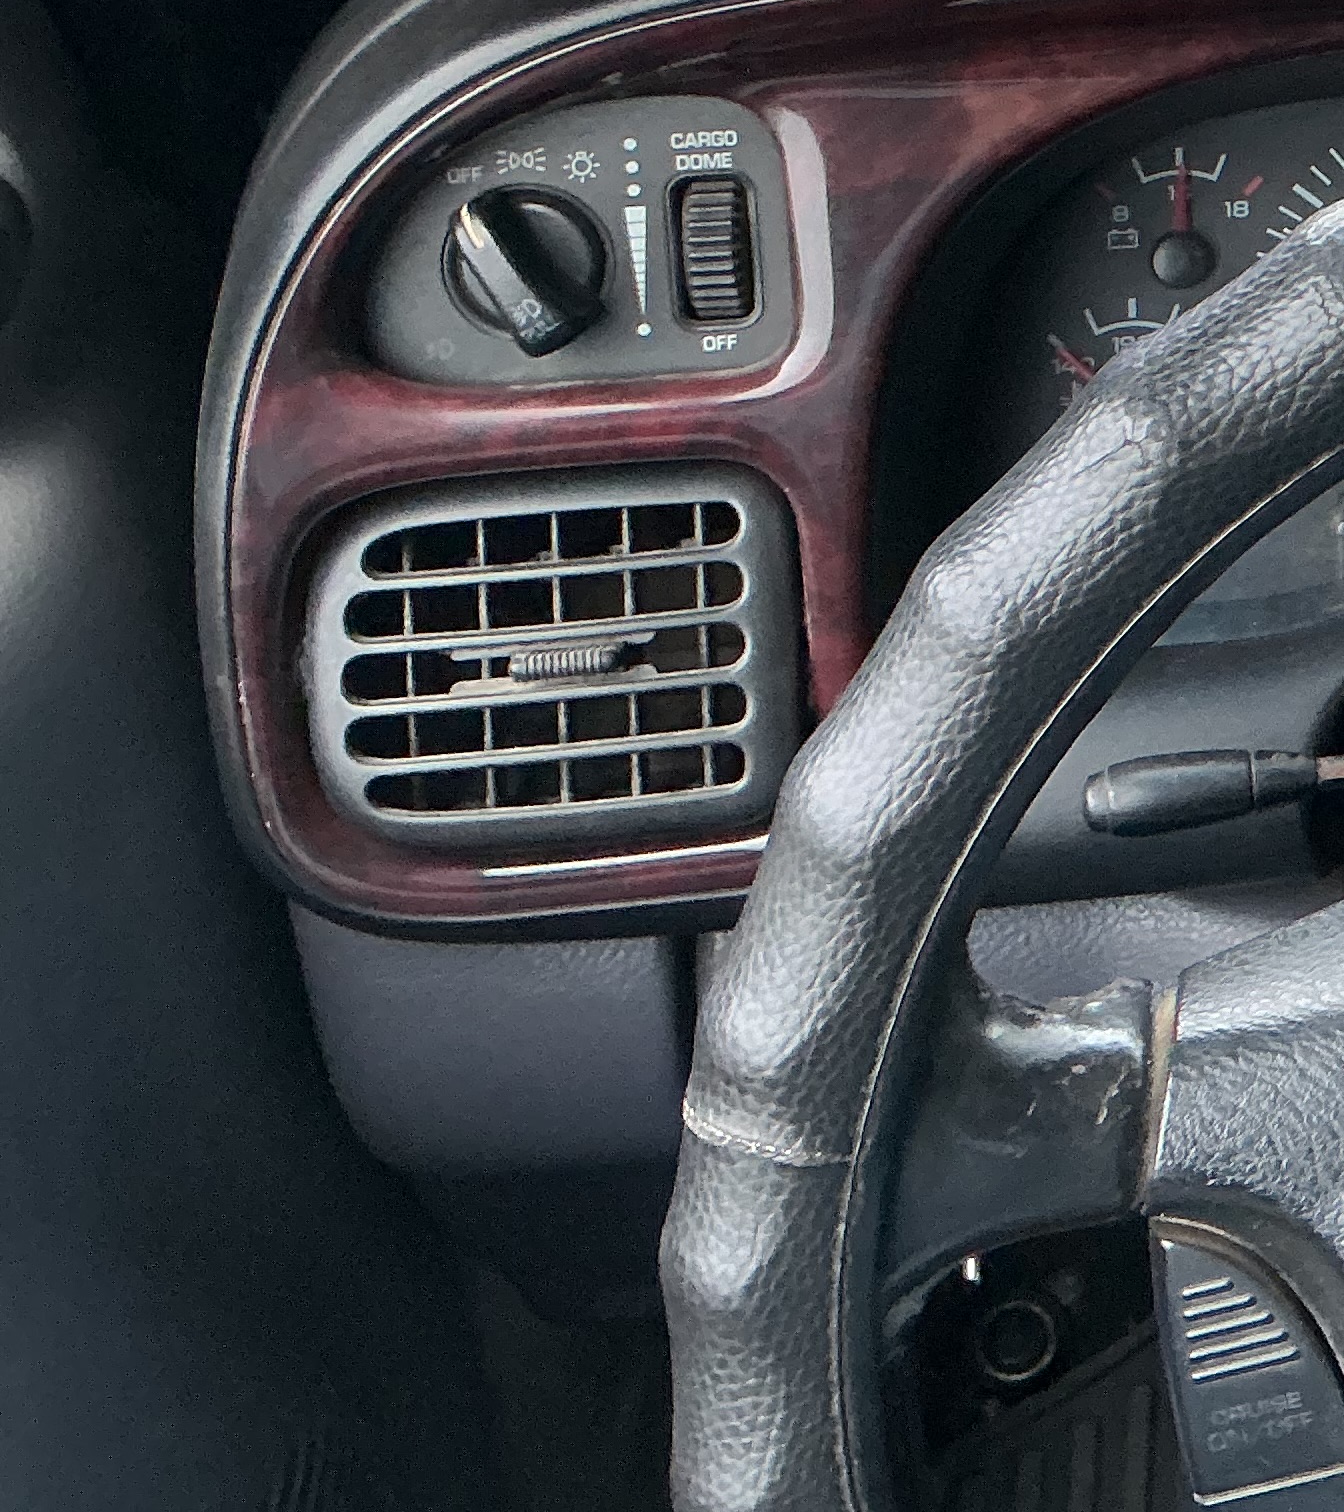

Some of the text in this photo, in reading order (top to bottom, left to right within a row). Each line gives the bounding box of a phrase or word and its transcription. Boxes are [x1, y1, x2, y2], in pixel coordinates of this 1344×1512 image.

[669, 130, 738, 150] CARGO
[675, 152, 733, 171] DOME
[447, 165, 484, 184] OFF
[1112, 199, 1250, 223] 8 18
[702, 334, 738, 354] OFF
